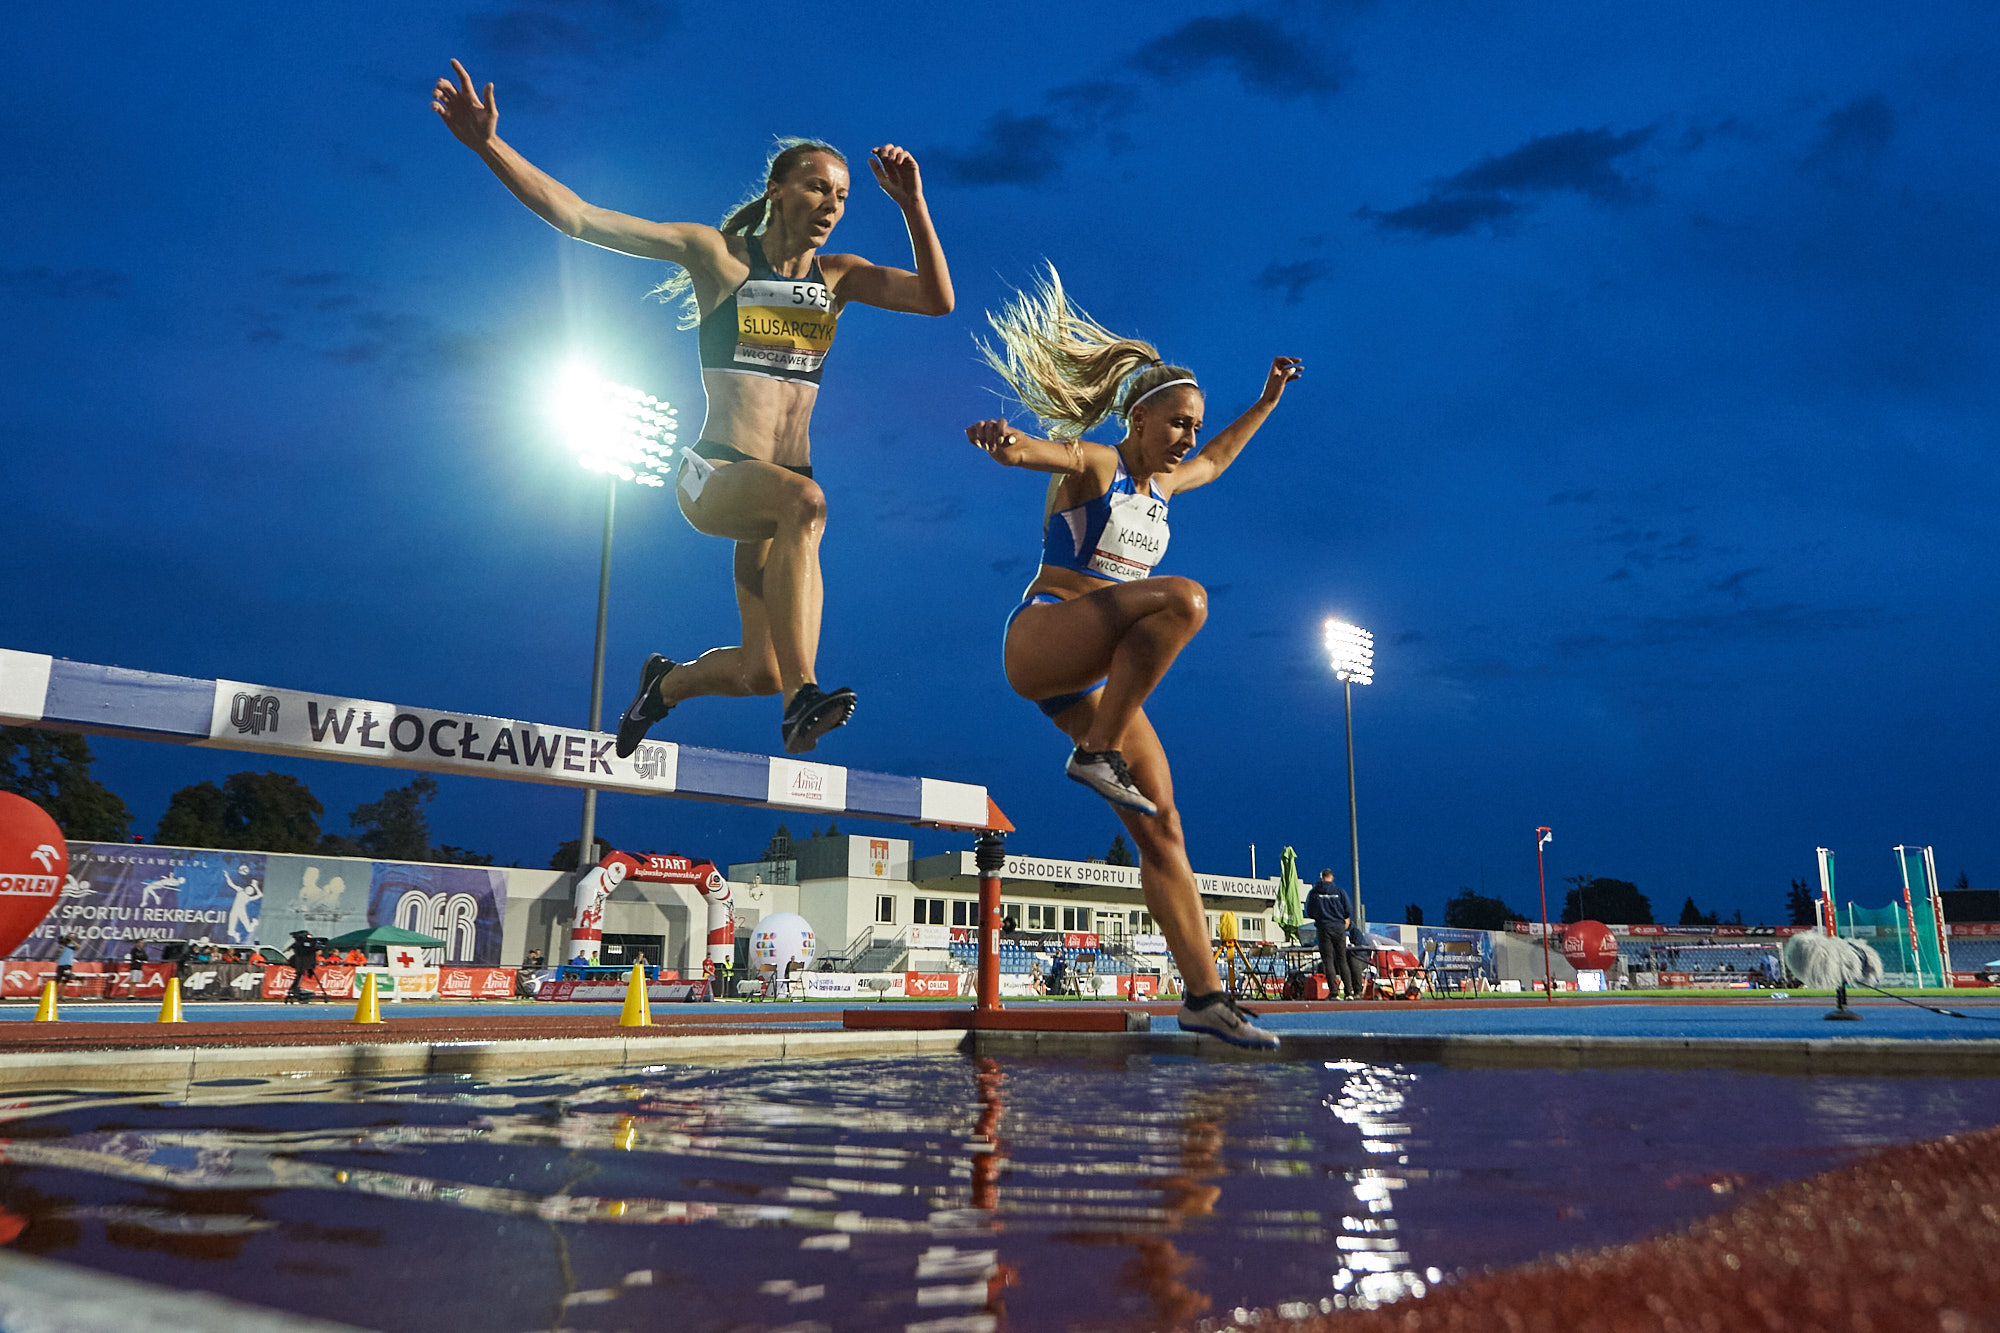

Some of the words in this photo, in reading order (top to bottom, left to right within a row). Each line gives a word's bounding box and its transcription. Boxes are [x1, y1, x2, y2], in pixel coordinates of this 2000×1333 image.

[792, 285, 828, 308] 595
[743, 315, 834, 341] ŚLUSARCZYK
[742, 349, 808, 366] WŁOCŁAWEK
[1118, 527, 1160, 552] KAPAŁA
[307, 701, 615, 776] WŁOCŁAWEK
[792, 770, 823, 791] Anwil
[650, 857, 687, 871] START
[1009, 858, 1072, 880] OŚRODEK
[1077, 864, 1125, 883] SPORTU
[0, 876, 53, 893] ORLEN
[1203, 878, 1218, 892] WE
[1222, 881, 1278, 897] WŁOCŁAWK
[61, 905, 130, 921] SPORTU
[142, 908, 227, 924] REKREACJI
[60, 924, 174, 941] WŁOCŁAWKU
[1019, 939, 1039, 947] SUUNTO
[183, 971, 218, 990] 4F
[230, 972, 265, 991] 4F
[443, 971, 472, 989] Anwil
[482, 971, 511, 989] Anwil
[929, 981, 948, 989] ORLEN
